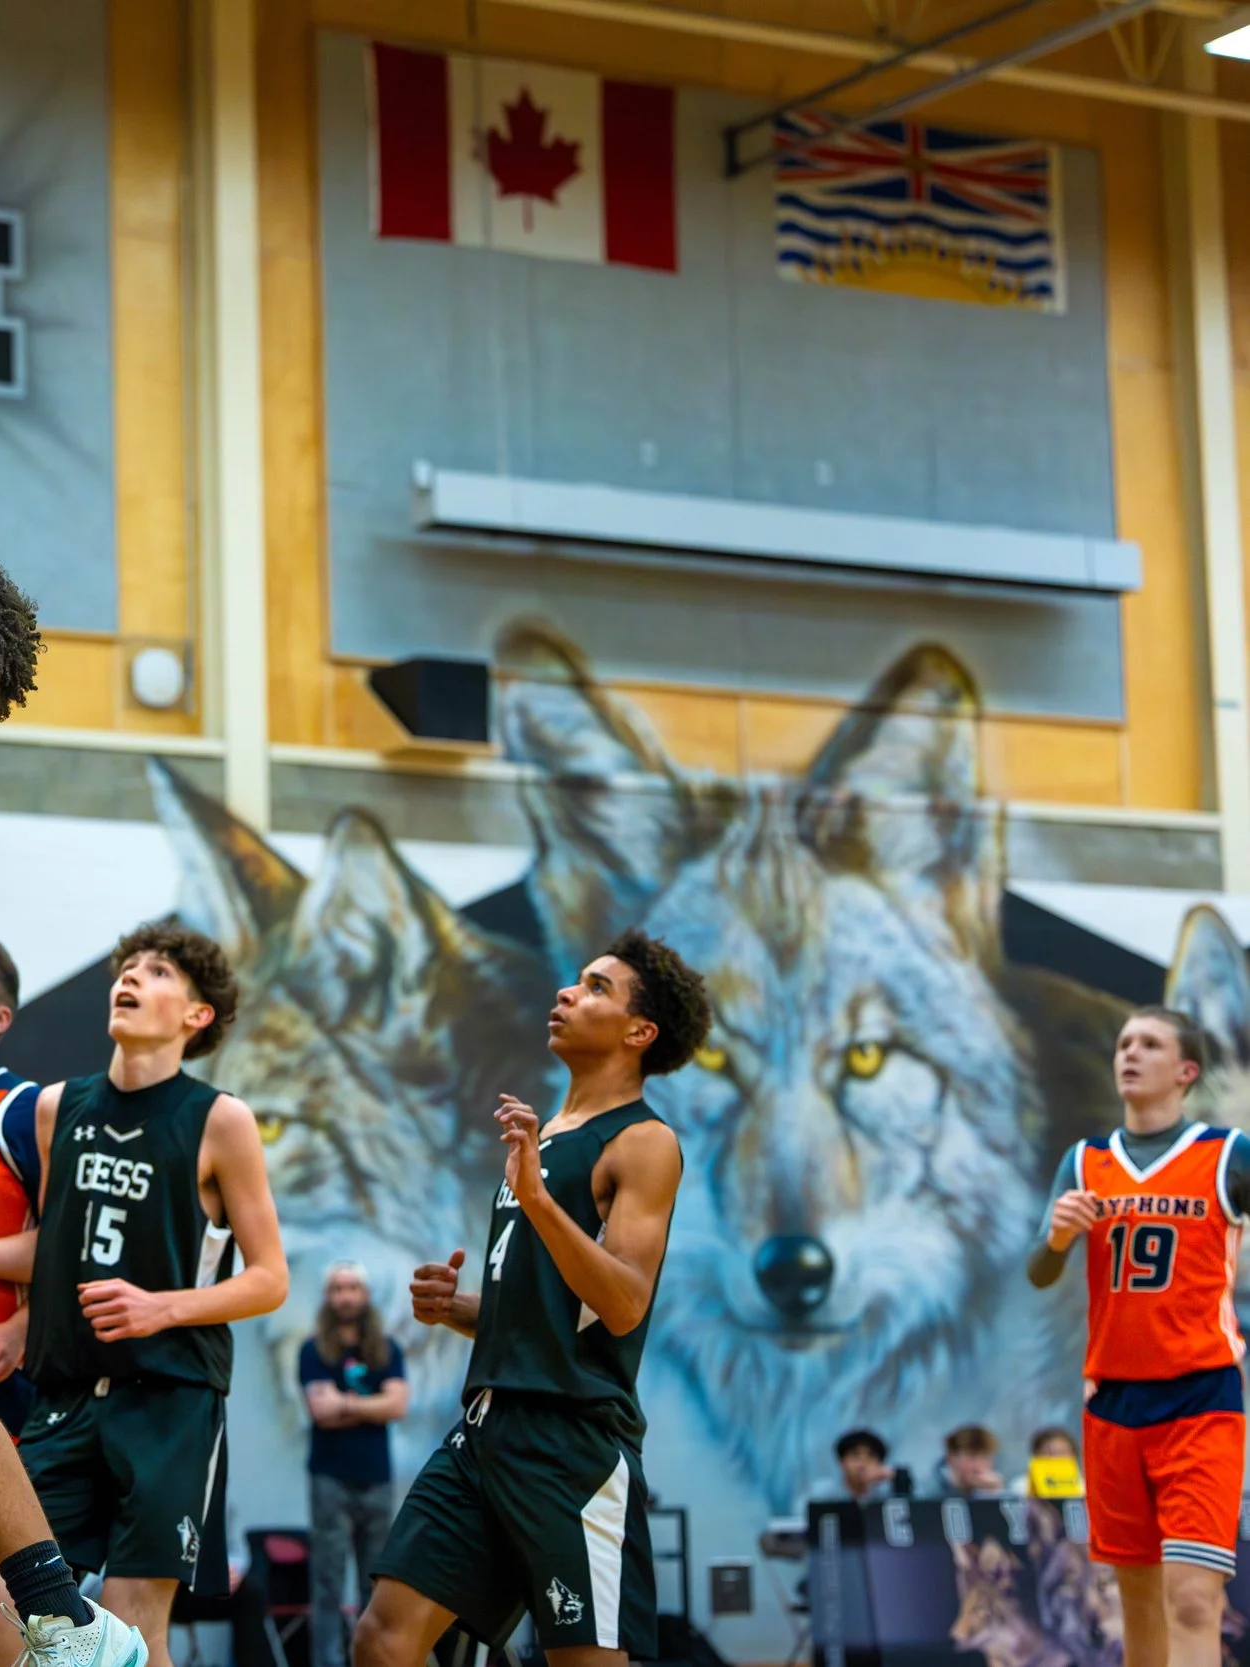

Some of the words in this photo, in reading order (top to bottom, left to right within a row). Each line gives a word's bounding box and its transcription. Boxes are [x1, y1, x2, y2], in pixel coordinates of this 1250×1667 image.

[75, 1152, 154, 1201] GESS
[1094, 1194, 1210, 1221] RYPHONS
[488, 1218, 517, 1282] 4
[1107, 1222, 1178, 1293] 19
[882, 1498, 1091, 1548] COYO
